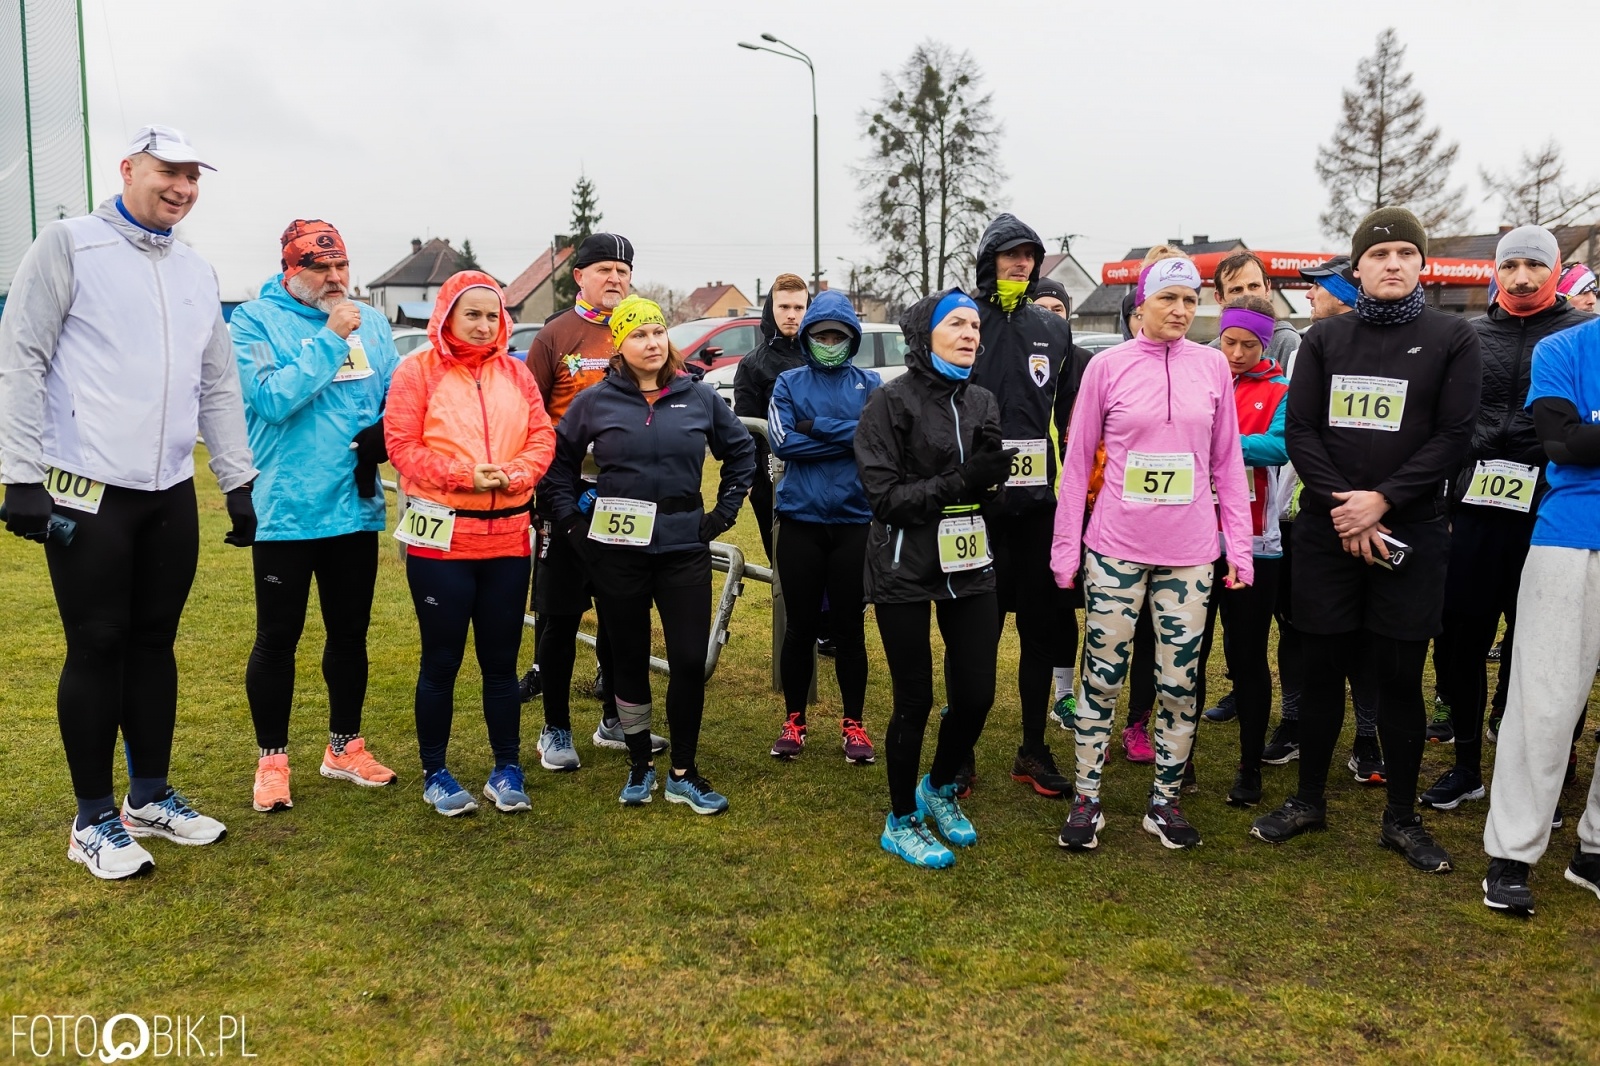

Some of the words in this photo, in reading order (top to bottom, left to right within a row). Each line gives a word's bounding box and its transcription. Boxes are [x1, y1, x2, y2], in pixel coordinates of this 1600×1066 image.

[1343, 393, 1391, 419] 116
[1010, 455, 1033, 477] 68
[45, 466, 92, 498] 100
[1143, 471, 1176, 494] 57
[1481, 475, 1523, 500] 102
[410, 512, 444, 539] 107
[607, 513, 636, 535] 55
[955, 534, 977, 559] 98
